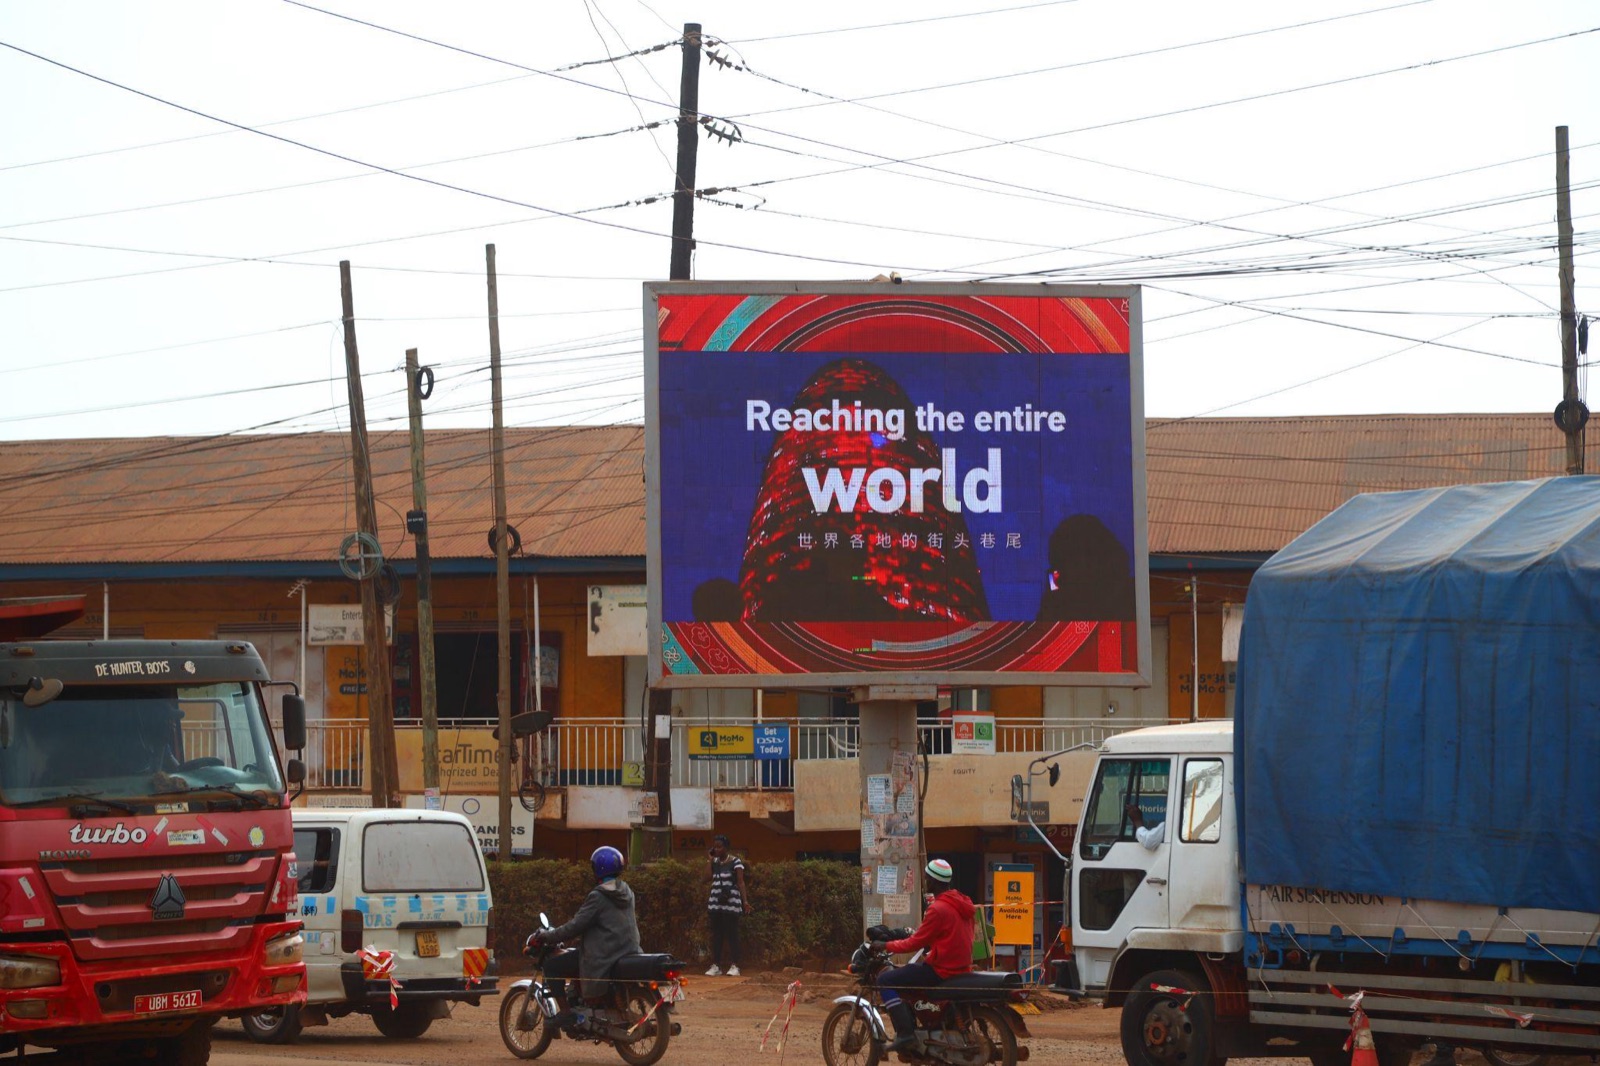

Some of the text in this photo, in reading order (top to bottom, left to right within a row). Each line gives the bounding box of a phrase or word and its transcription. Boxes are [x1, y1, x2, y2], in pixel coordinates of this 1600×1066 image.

[746, 399, 1066, 440] Reaching the entire
[801, 447, 1002, 514] world
[797, 532, 1022, 550] 世界各地的街头巷尾
[95, 661, 170, 677] DE HUNTER BOYS
[764, 727, 777, 736] Get
[760, 745, 783, 755] Today
[69, 823, 147, 845] turbo
[39, 849, 92, 860] HOWO
[1271, 886, 1384, 905] AIR SUSPENSION
[148, 992, 197, 1011] UBM 561Z
